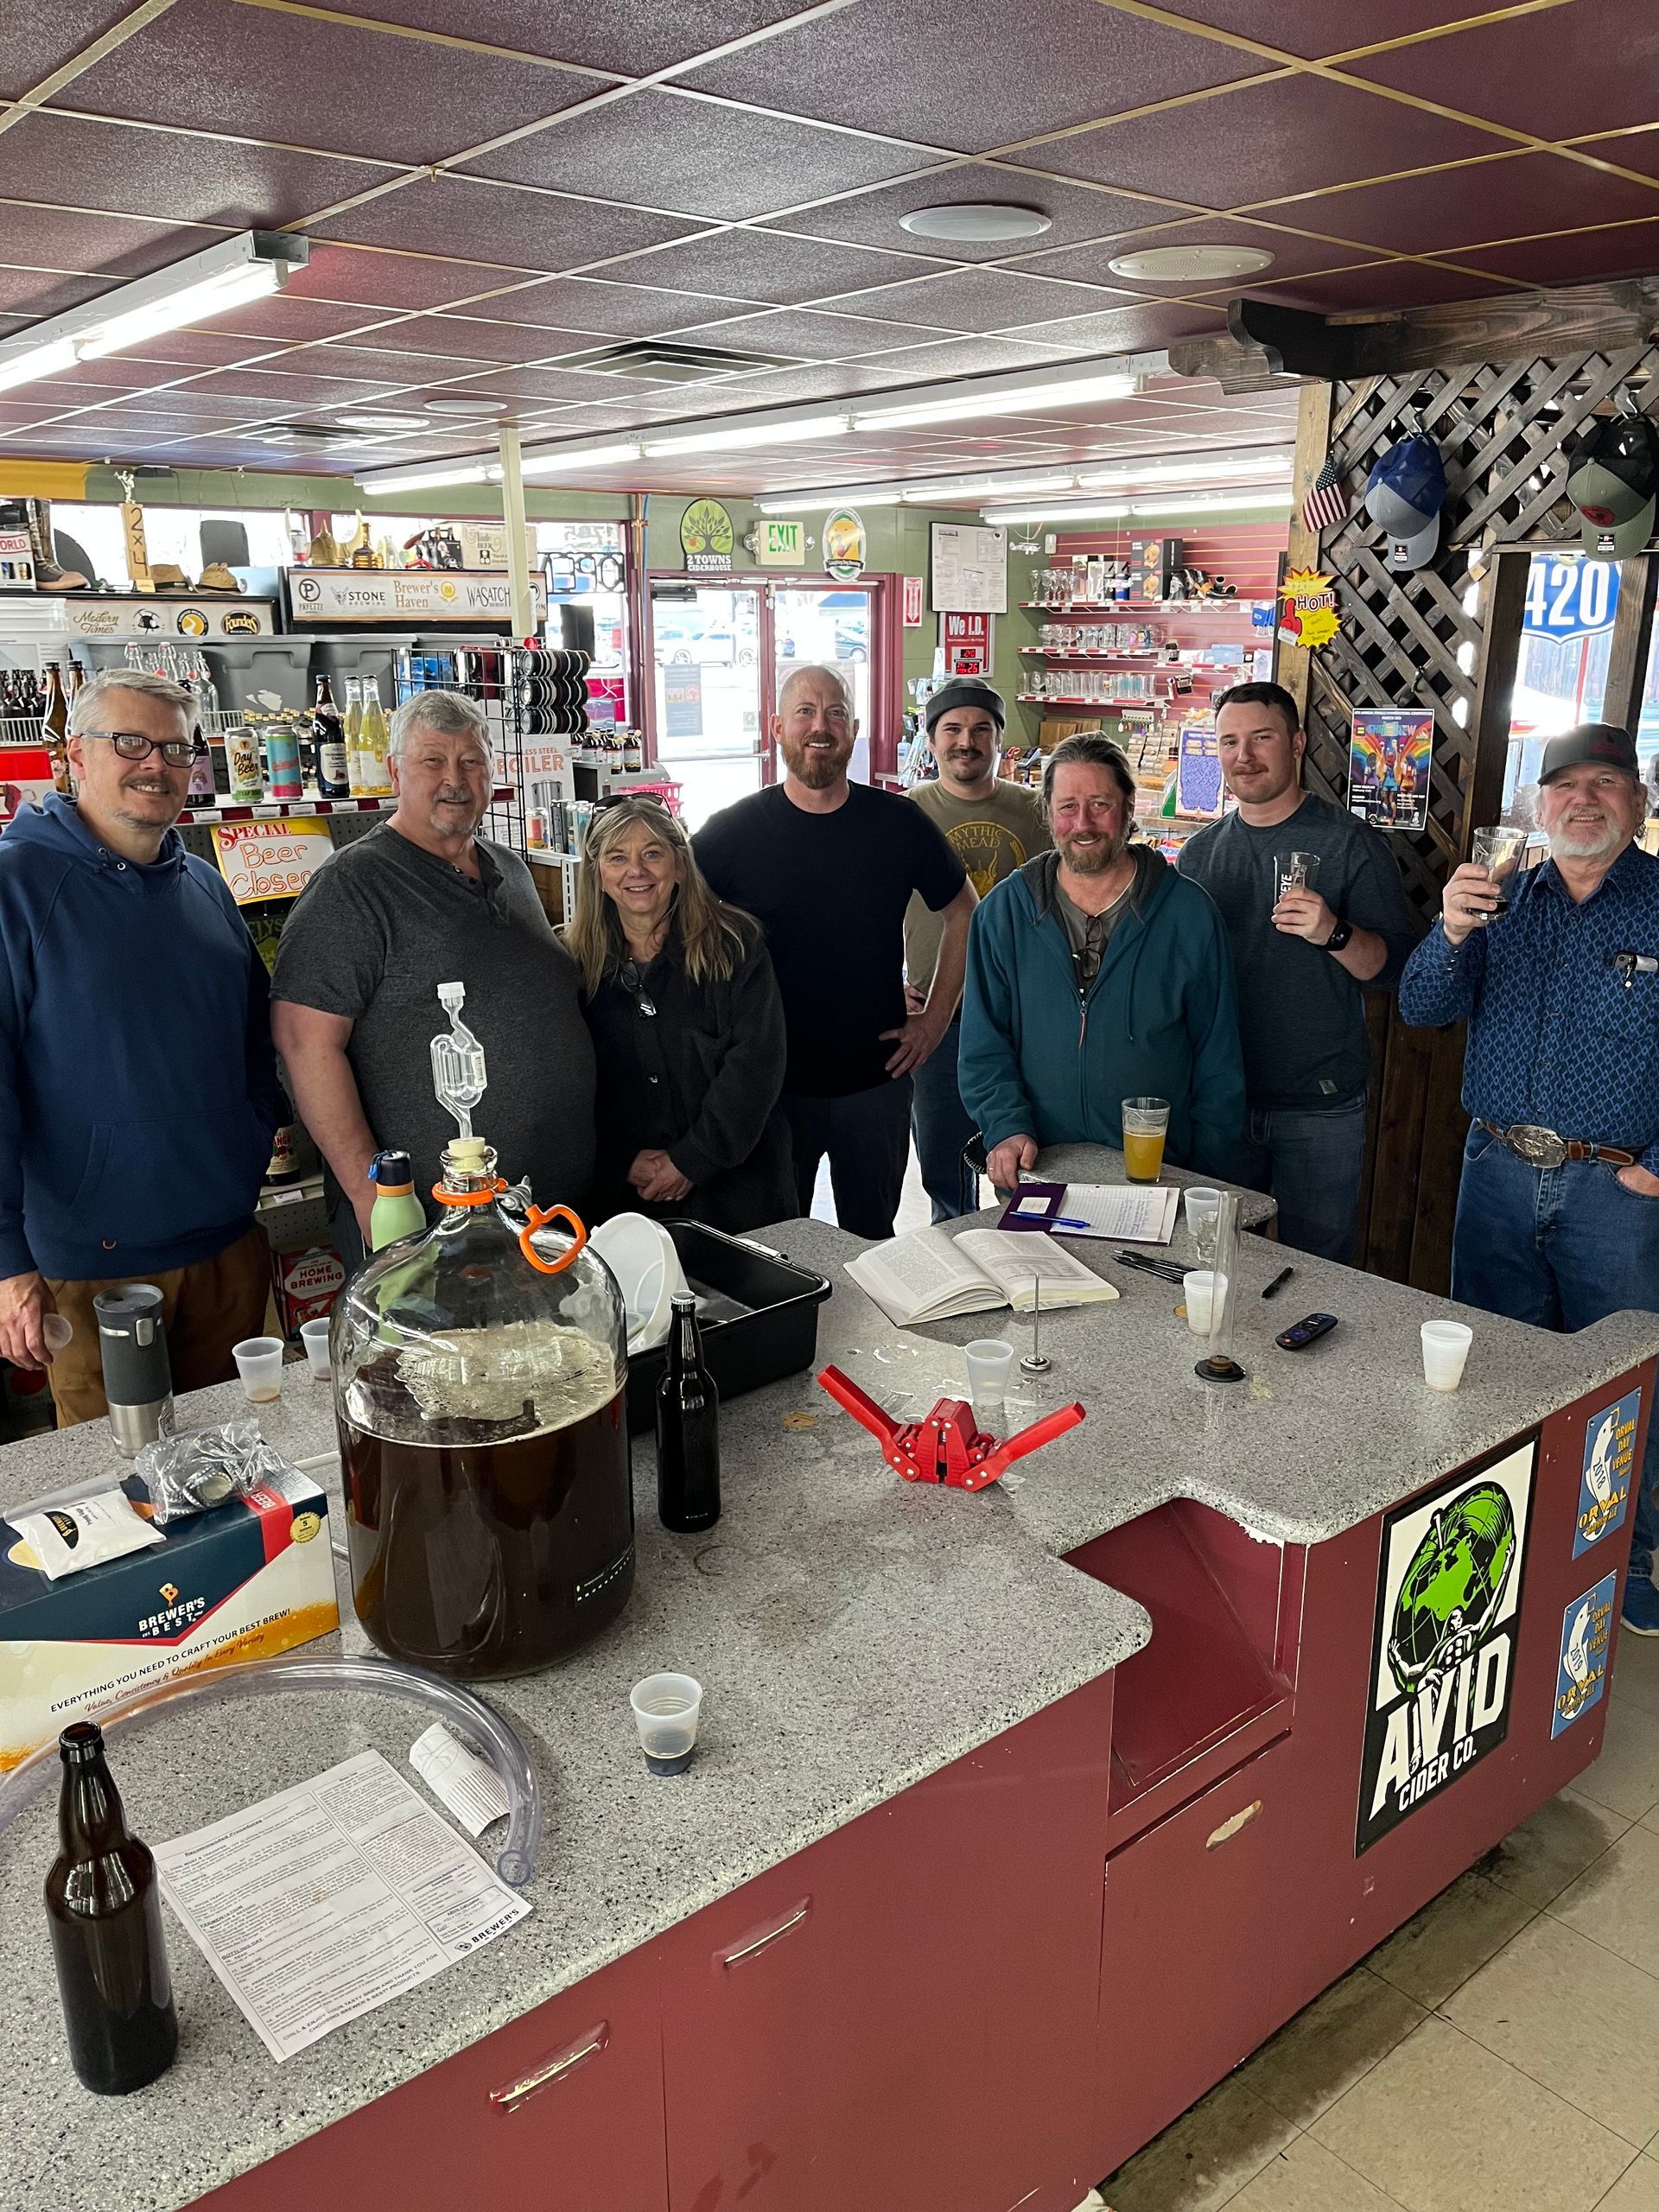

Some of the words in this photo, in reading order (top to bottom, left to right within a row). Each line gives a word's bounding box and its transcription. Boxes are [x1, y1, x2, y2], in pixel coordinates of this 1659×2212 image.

[768, 524, 798, 552] EXIT
[686, 555, 695, 565] 2
[696, 554, 732, 565] TOWNS
[348, 592, 385, 601] STONE
[393, 581, 439, 594] Brewer's
[467, 587, 511, 607] WASATCH
[1524, 561, 1610, 626] 420
[395, 594, 429, 608] Haven
[1297, 592, 1334, 611] HOT!
[73, 609, 119, 626] Modern
[80, 622, 115, 635] Times
[225, 614, 257, 633] Founders
[949, 616, 965, 636] We
[969, 616, 984, 636] I.D.
[234, 752, 253, 766] Day
[238, 762, 259, 776] Beer
[497, 754, 564, 776] BOILER
[217, 823, 292, 851] SPECIAL
[947, 826, 1002, 844] MYTHIC
[957, 837, 1001, 851] MEAD
[239, 842, 308, 869] Beer
[1280, 873, 1293, 895] EYE
[290, 1271, 343, 1290] BREWING
[299, 1264, 332, 1280] HOME
[1616, 1418, 1636, 1440] ORVAL
[1618, 1436, 1630, 1453] DAY
[1612, 1448, 1632, 1471] VENUE
[1592, 1457, 1605, 1490] 2018
[1579, 1486, 1627, 1529] ORVAL
[1608, 1506, 1618, 1519] ALE
[138, 1597, 206, 1631] BREWER'S
[1592, 1601, 1611, 1623] ORVAL
[152, 1612, 193, 1636] BEST
[1594, 1620, 1605, 1634] DAY
[1589, 1630, 1609, 1652] VENUE
[51, 1681, 114, 1712] EVERYTHING
[116, 1671, 137, 1685] YOU
[139, 1660, 164, 1676] NEED
[166, 1655, 179, 1664] TO
[181, 1641, 210, 1658] CRAFT
[213, 1630, 238, 1645] YOUR
[239, 1620, 261, 1634] BEST
[263, 1608, 290, 1624] BREW!
[1570, 1642, 1583, 1672] 2019
[85, 1699, 112, 1712] Value,
[115, 1678, 161, 1700] Consistency
[162, 1672, 169, 1681] &
[172, 1660, 202, 1675] Quality
[214, 1646, 235, 1658] Every
[237, 1632, 265, 1648] Variety
[1557, 1663, 1605, 1710] ORVAL
[1369, 1633, 1510, 1821] AVID
[1399, 1751, 1449, 1811] CIDER
[1452, 1735, 1477, 1771] CO.
[469, 1908, 521, 1943] BREWER'S
[282, 2028, 301, 2041] CHILL
[306, 2012, 327, 2027] ENJOY
[344, 1993, 362, 2006] TASTY
[380, 1978, 393, 1988] AND
[393, 1967, 413, 1980] THANK
[413, 1960, 426, 1969] YOU
[425, 1952, 438, 1962] FOR
